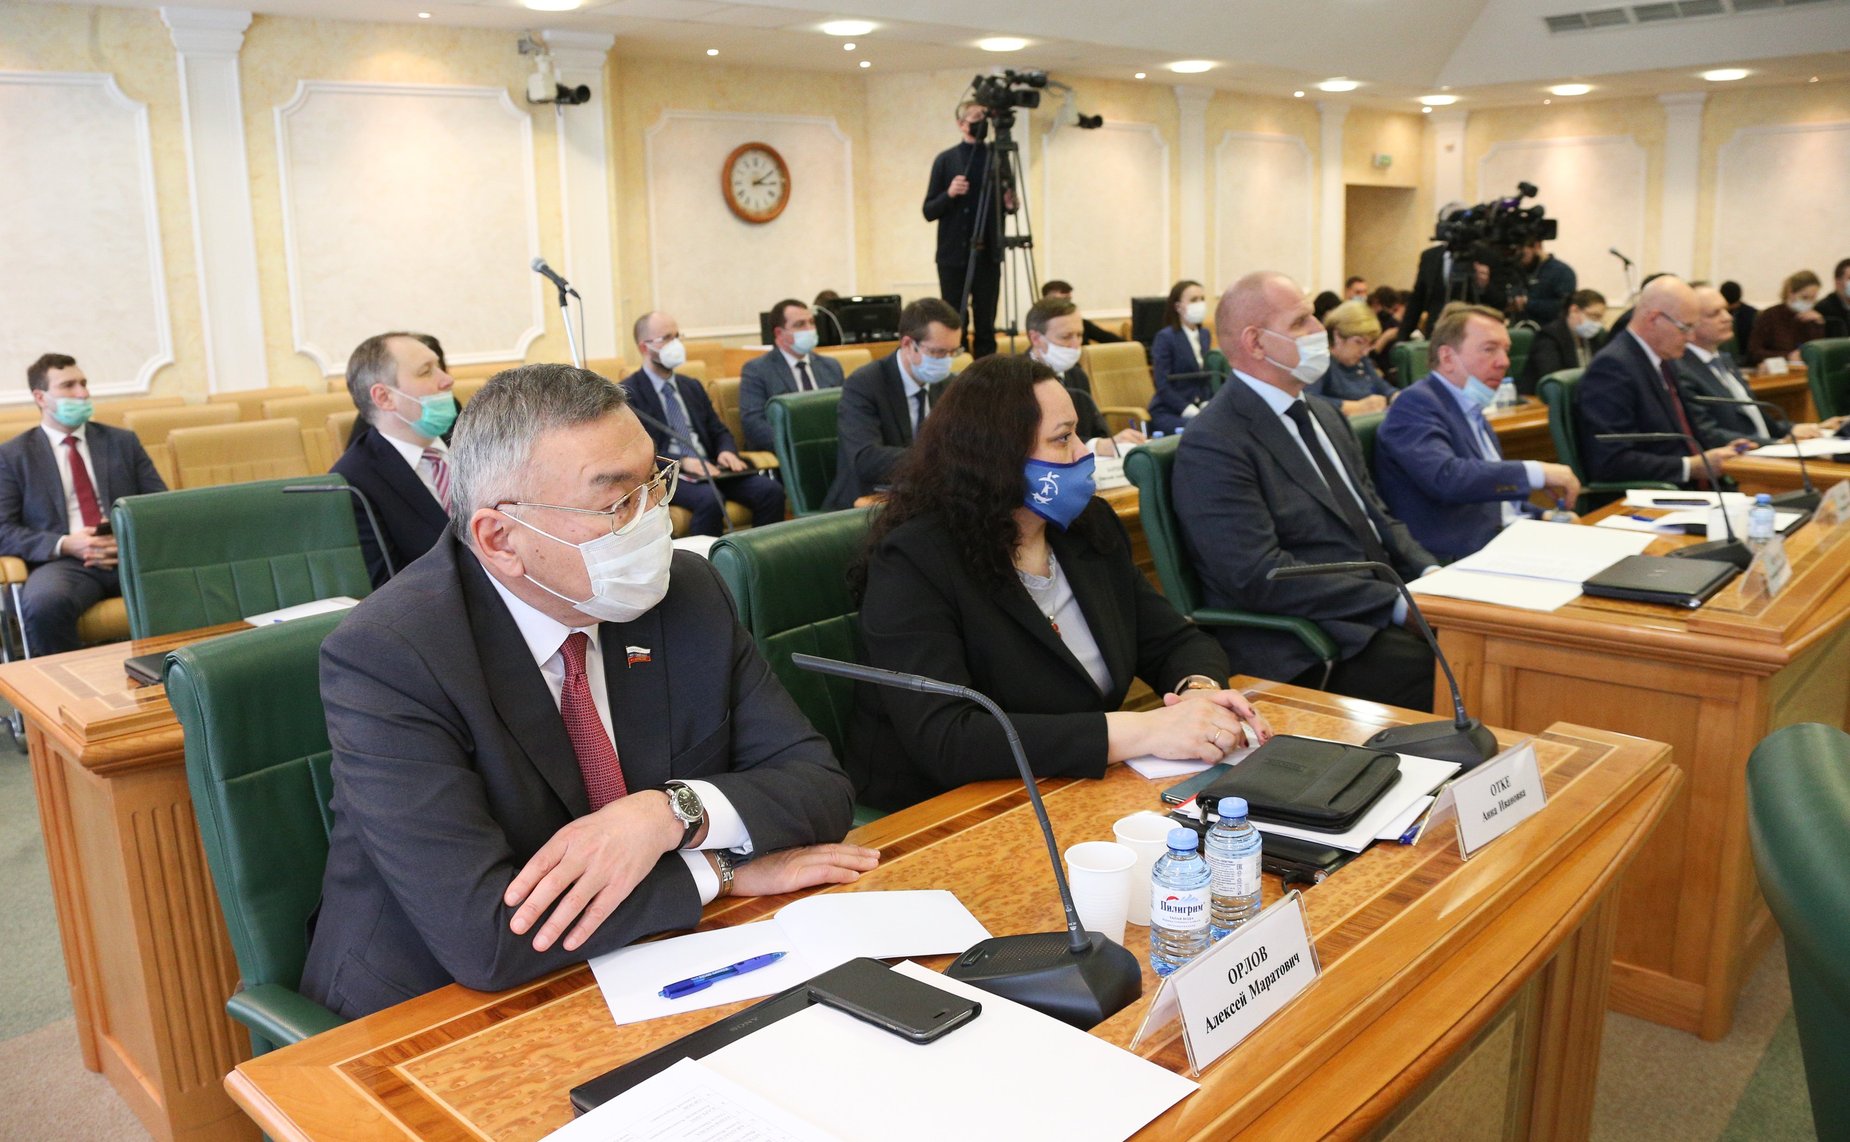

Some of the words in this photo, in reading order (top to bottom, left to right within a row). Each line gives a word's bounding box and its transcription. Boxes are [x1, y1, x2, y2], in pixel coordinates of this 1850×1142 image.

[1490, 776, 1512, 796] ОТКЕ
[1160, 900, 1203, 916] Пилигрим
[1228, 946, 1268, 984] ОРЛОВ
[1205, 991, 1247, 1034] Алексей
[1248, 952, 1300, 999] Маратович
